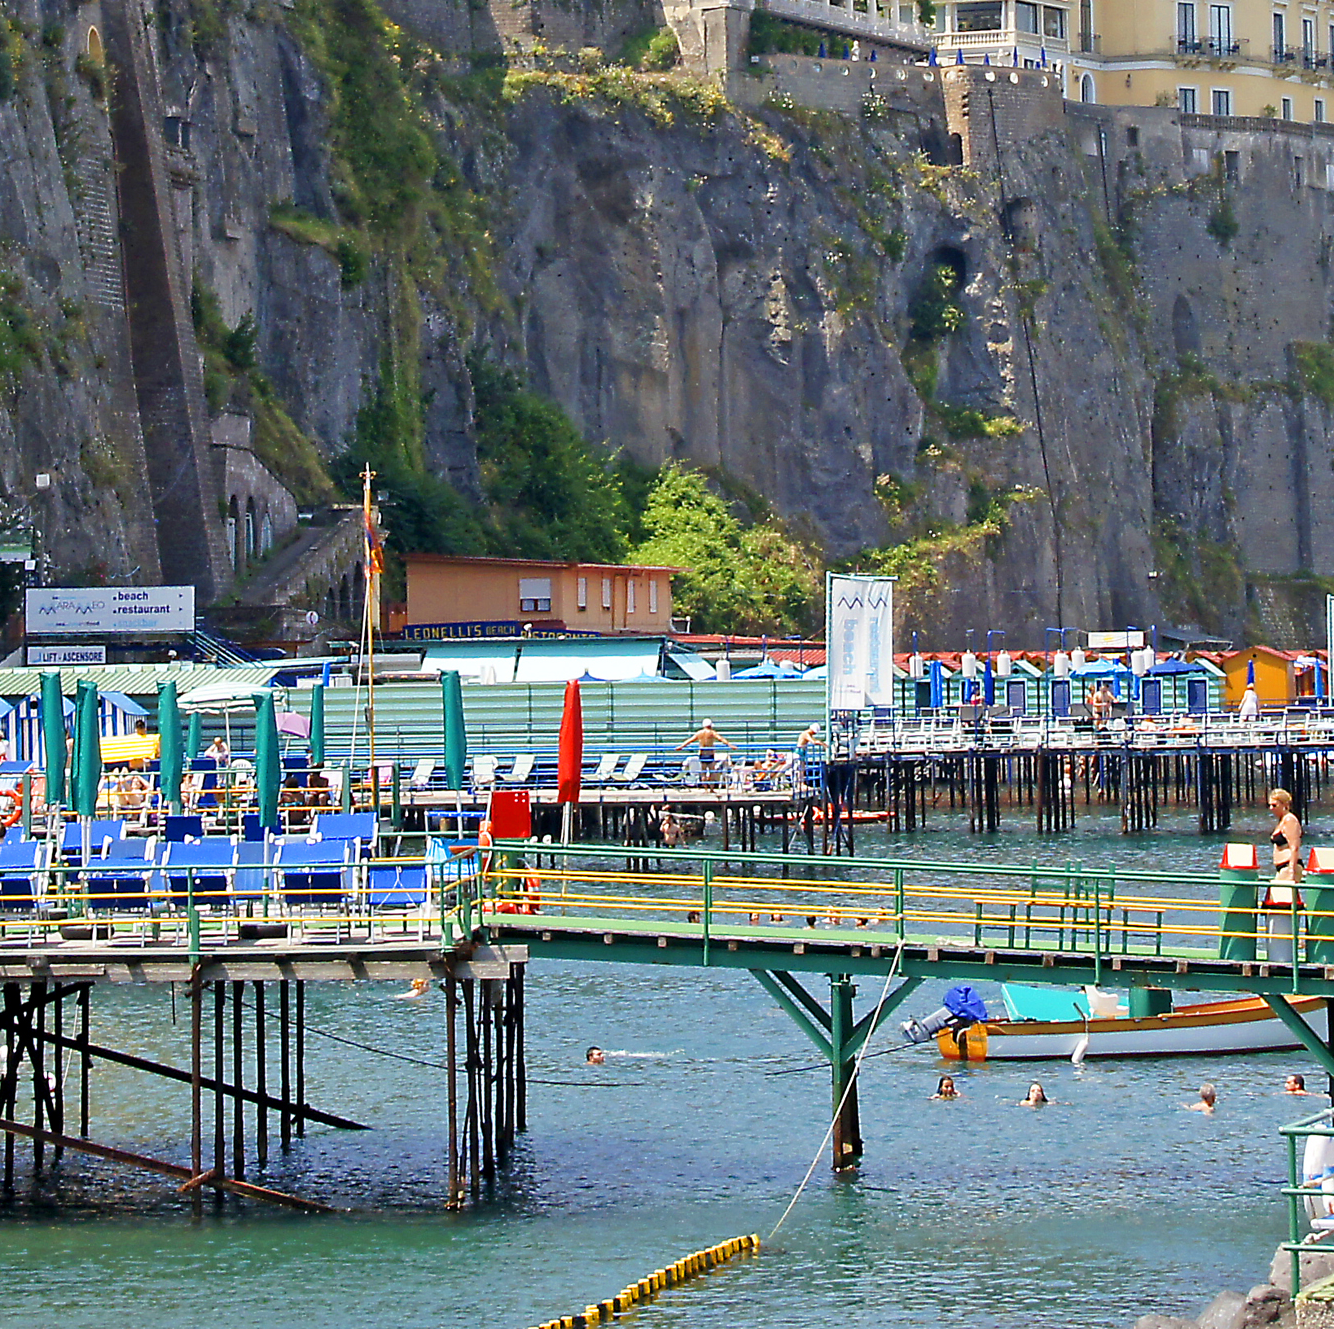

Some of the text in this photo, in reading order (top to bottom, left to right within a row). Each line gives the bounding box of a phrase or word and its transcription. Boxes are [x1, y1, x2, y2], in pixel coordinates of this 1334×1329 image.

[118, 591, 149, 601] beach
[117, 604, 171, 614] restaurant
[405, 624, 482, 640] LEONELLI'S
[43, 652, 58, 662] LIFT
[63, 651, 102, 662] ASCENSORE
